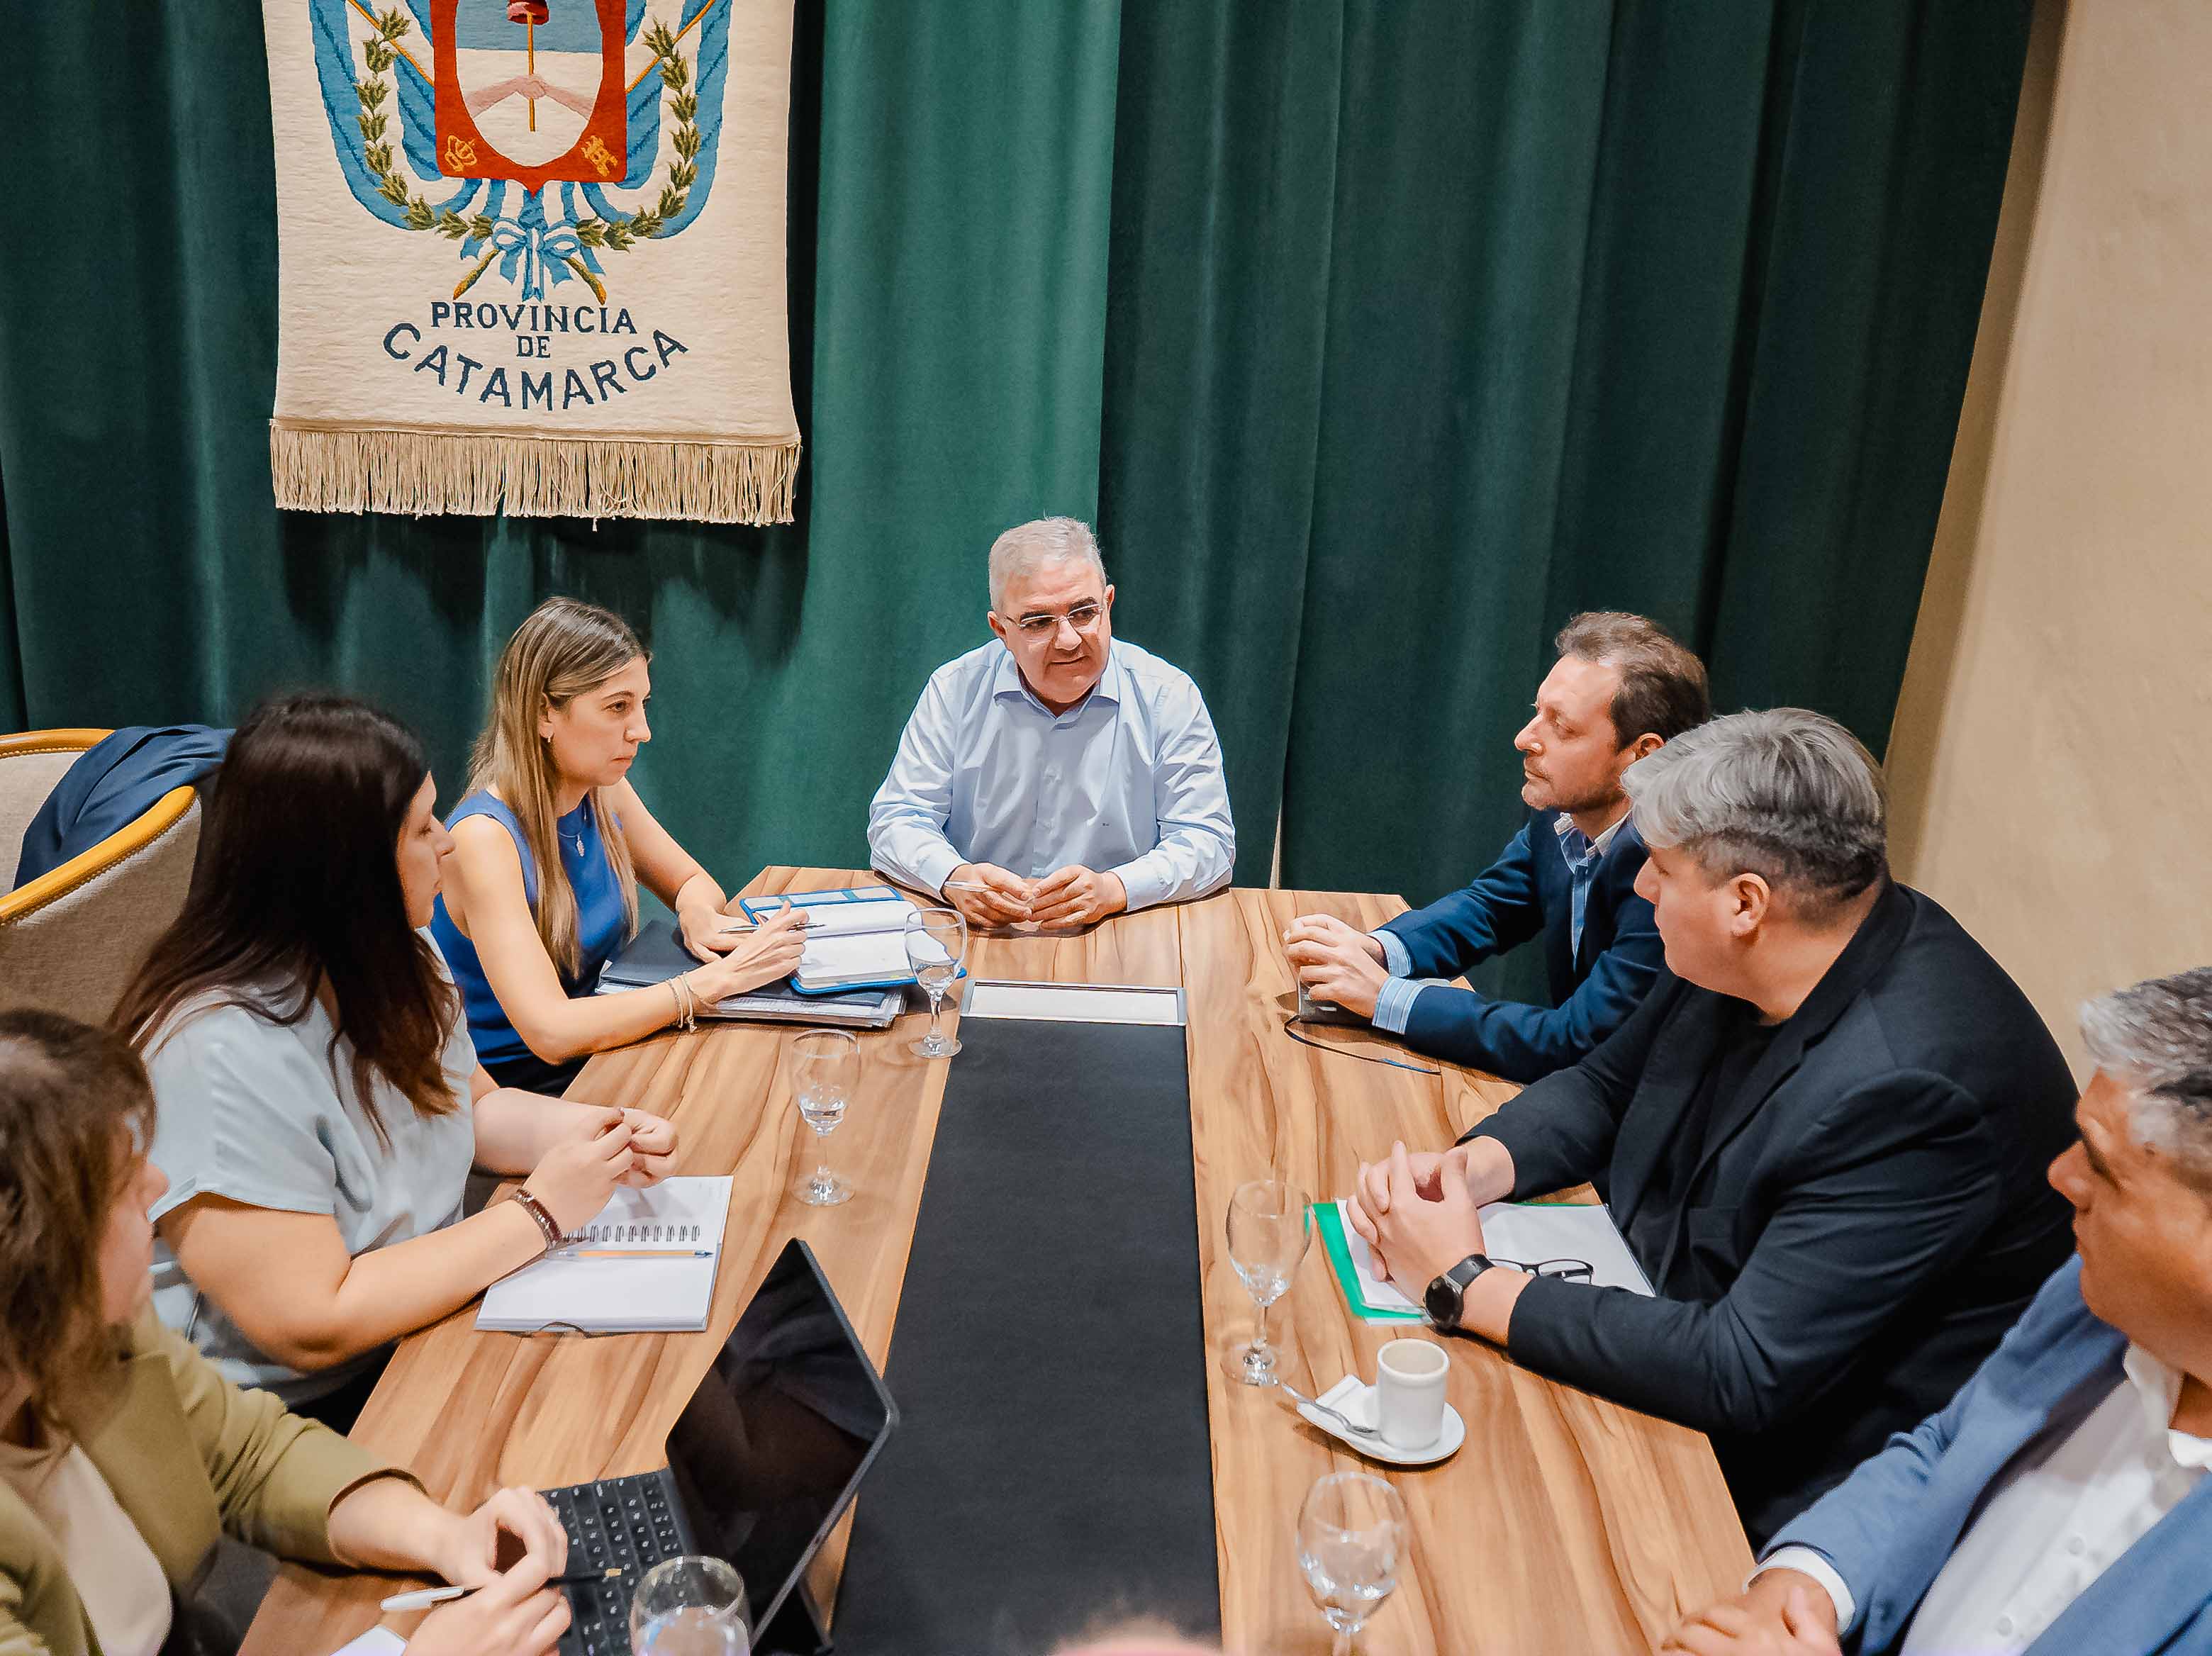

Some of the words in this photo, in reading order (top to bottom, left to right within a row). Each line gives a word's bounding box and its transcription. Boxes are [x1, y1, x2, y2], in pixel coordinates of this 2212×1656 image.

[430, 301, 638, 335] PROVINCIA
[515, 335, 551, 359] DE
[382, 323, 689, 411] CATAMARCA
